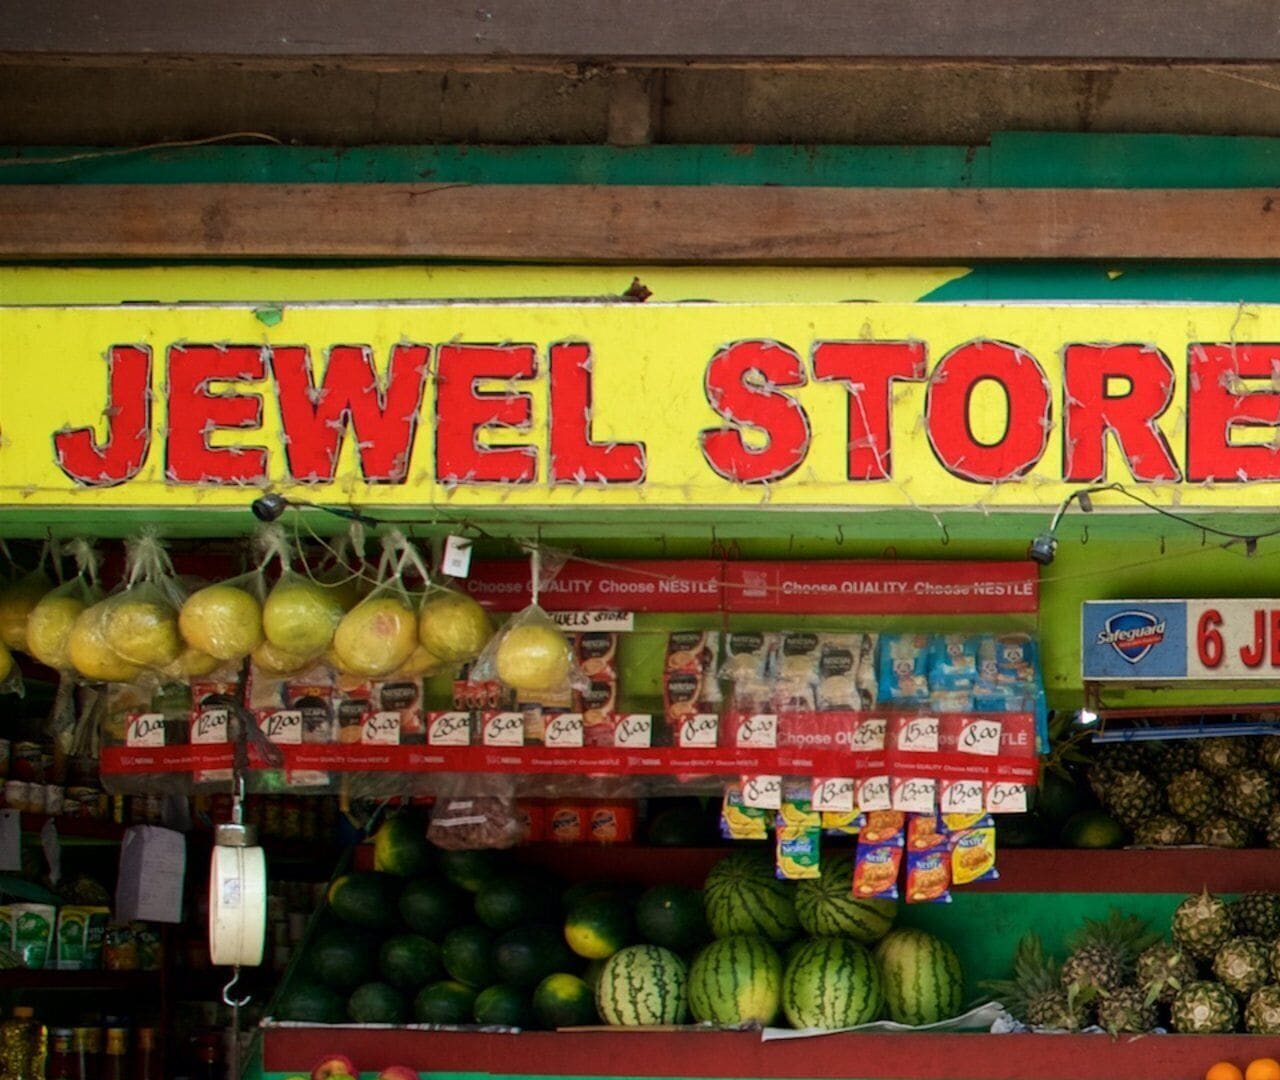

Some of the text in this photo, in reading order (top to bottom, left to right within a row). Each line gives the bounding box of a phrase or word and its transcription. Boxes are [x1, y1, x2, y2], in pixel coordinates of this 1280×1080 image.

[53, 341, 648, 486] JEWEL
[467, 579, 523, 593] Choose
[599, 578, 655, 593] Choose
[658, 576, 718, 593] NESTLÉ
[782, 581, 838, 595] Choose
[841, 581, 906, 595] QUALITY
[914, 581, 970, 596] Choose
[973, 579, 1033, 596] NESTLÉ
[1095, 619, 1166, 645] Safeguard
[1196, 608, 1224, 668] 6
[267, 715, 300, 736] 12.00
[366, 717, 400, 740] 8.00
[549, 719, 583, 741] 3.00
[617, 719, 651, 744] 8.00
[685, 718, 718, 742] 8.00
[741, 719, 773, 742] 8.00
[963, 724, 998, 747] 8.00
[747, 779, 782, 802] 8.00
[819, 781, 854, 805] 13.00
[947, 782, 982, 806] 13.00
